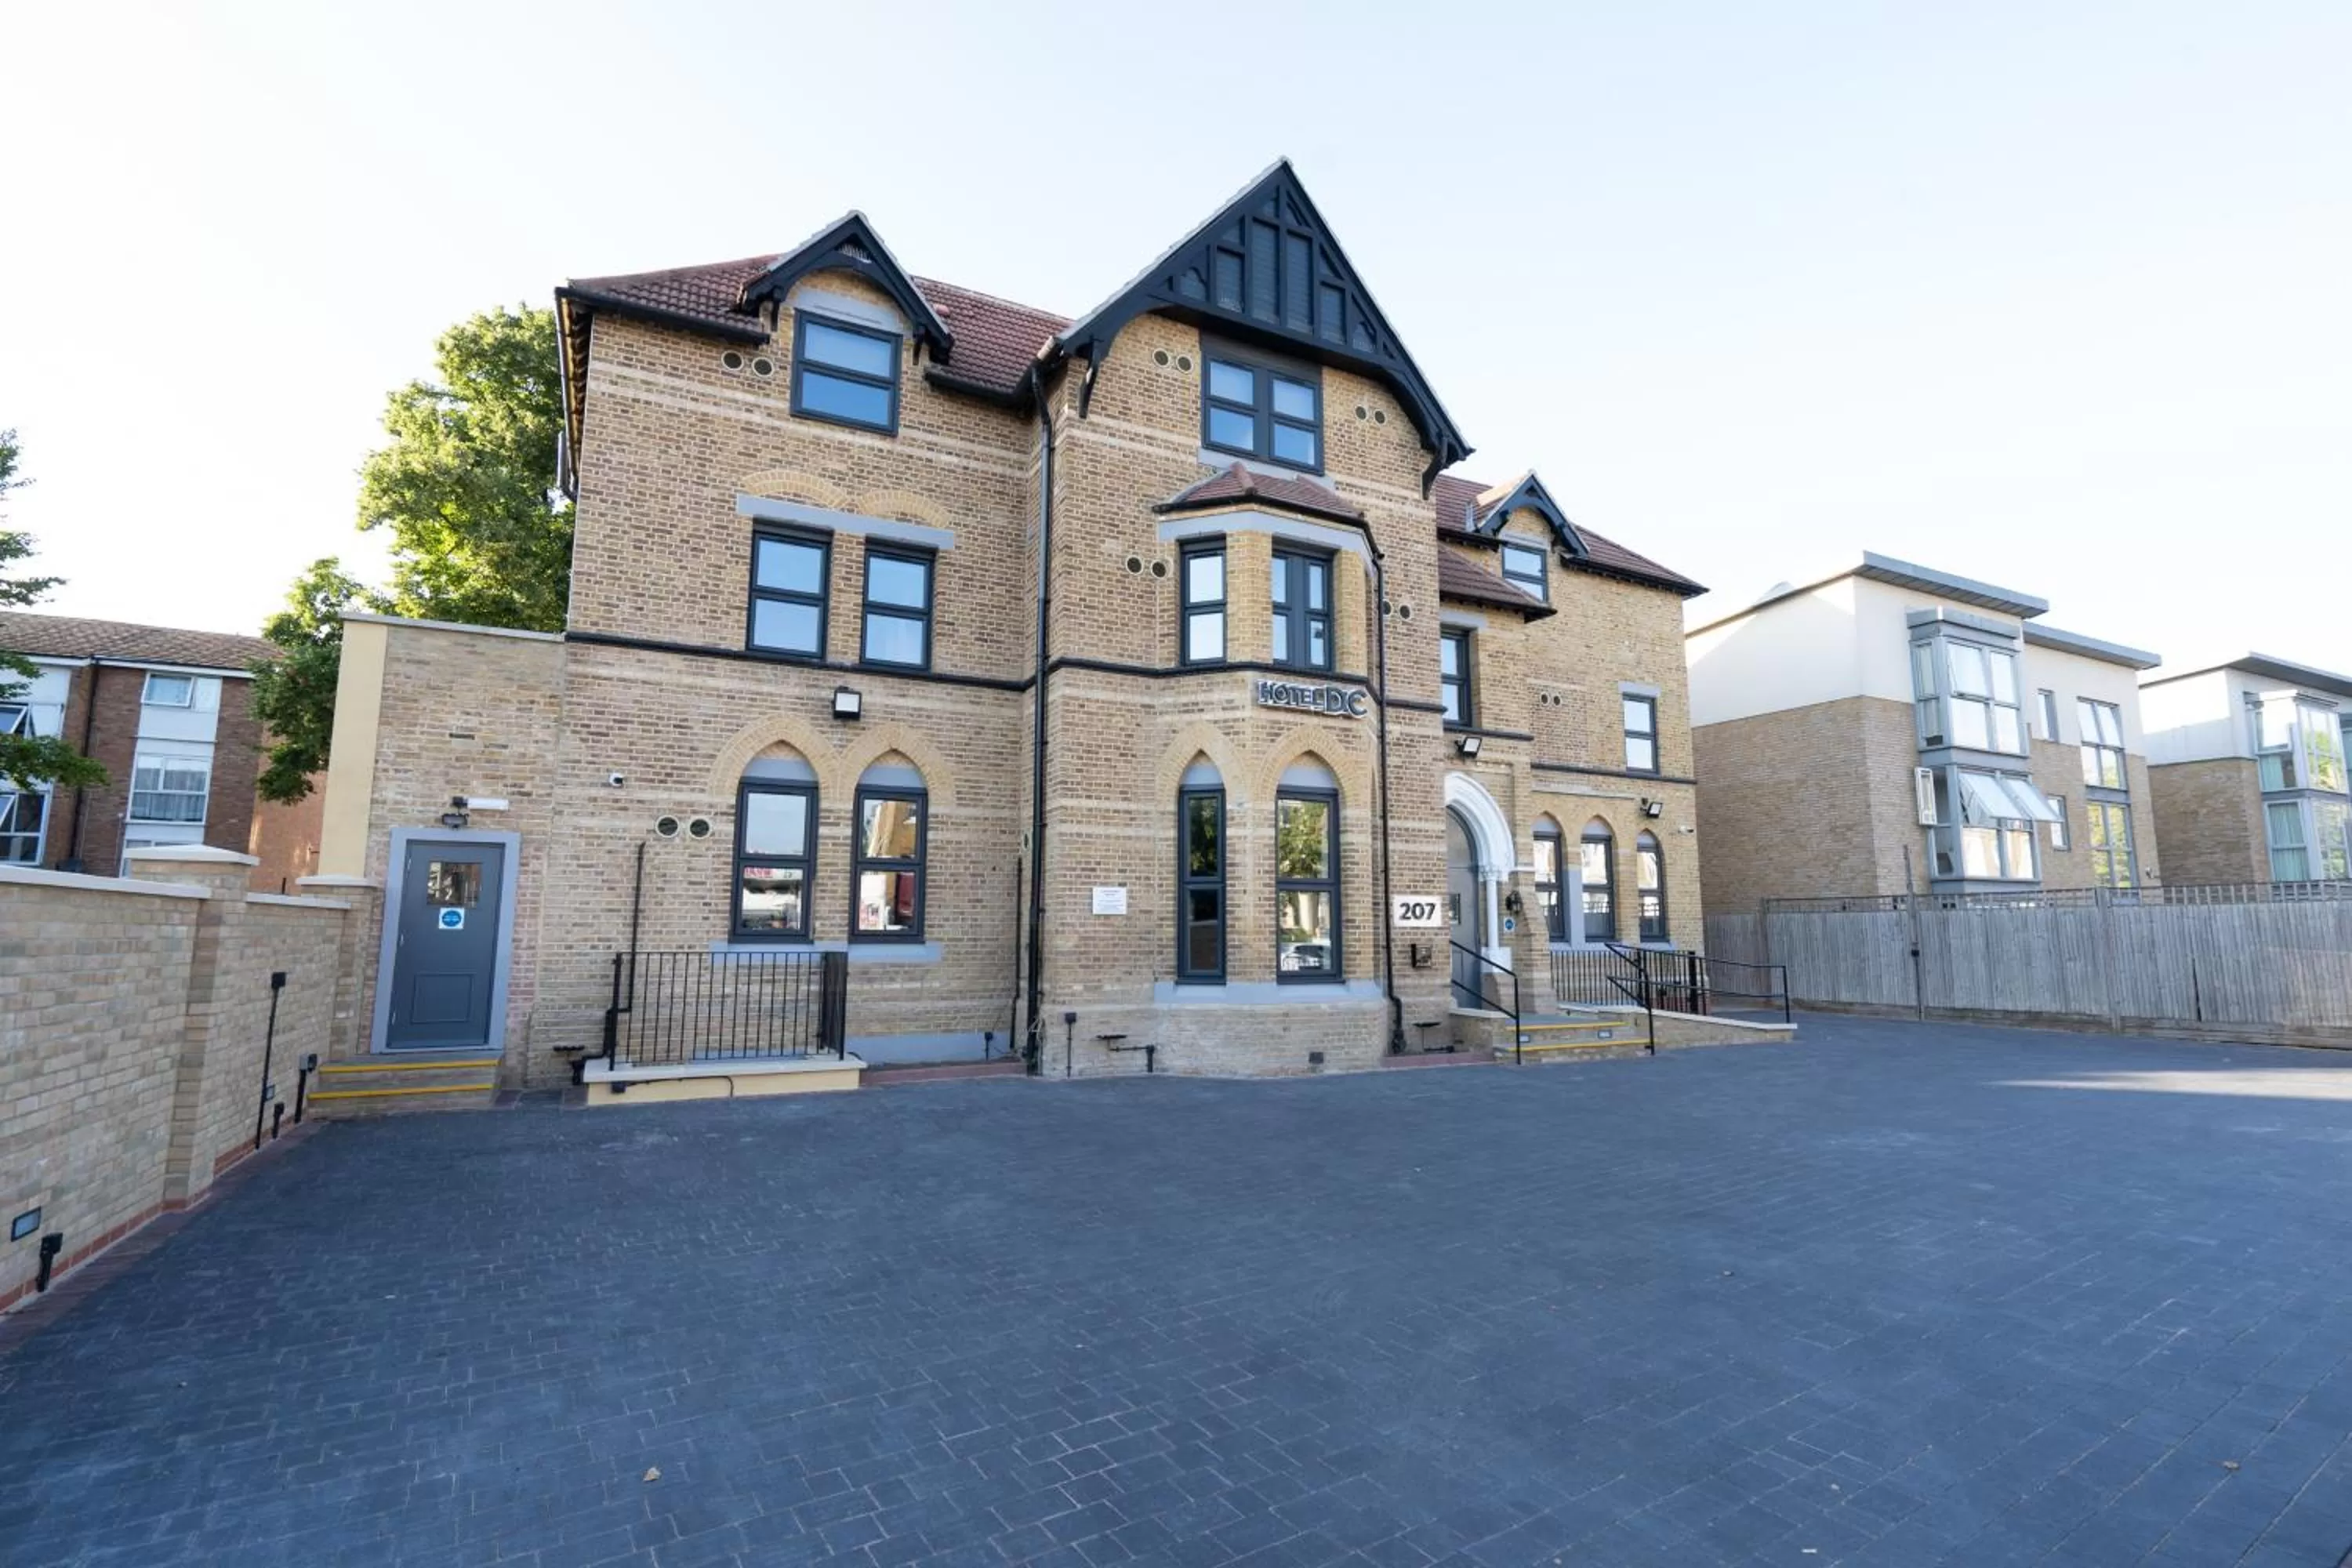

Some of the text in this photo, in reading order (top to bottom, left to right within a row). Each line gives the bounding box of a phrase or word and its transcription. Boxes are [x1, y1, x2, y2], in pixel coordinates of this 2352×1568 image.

[1258, 680, 1368, 717] HOTEL DC
[1399, 902, 1436, 920] 207
